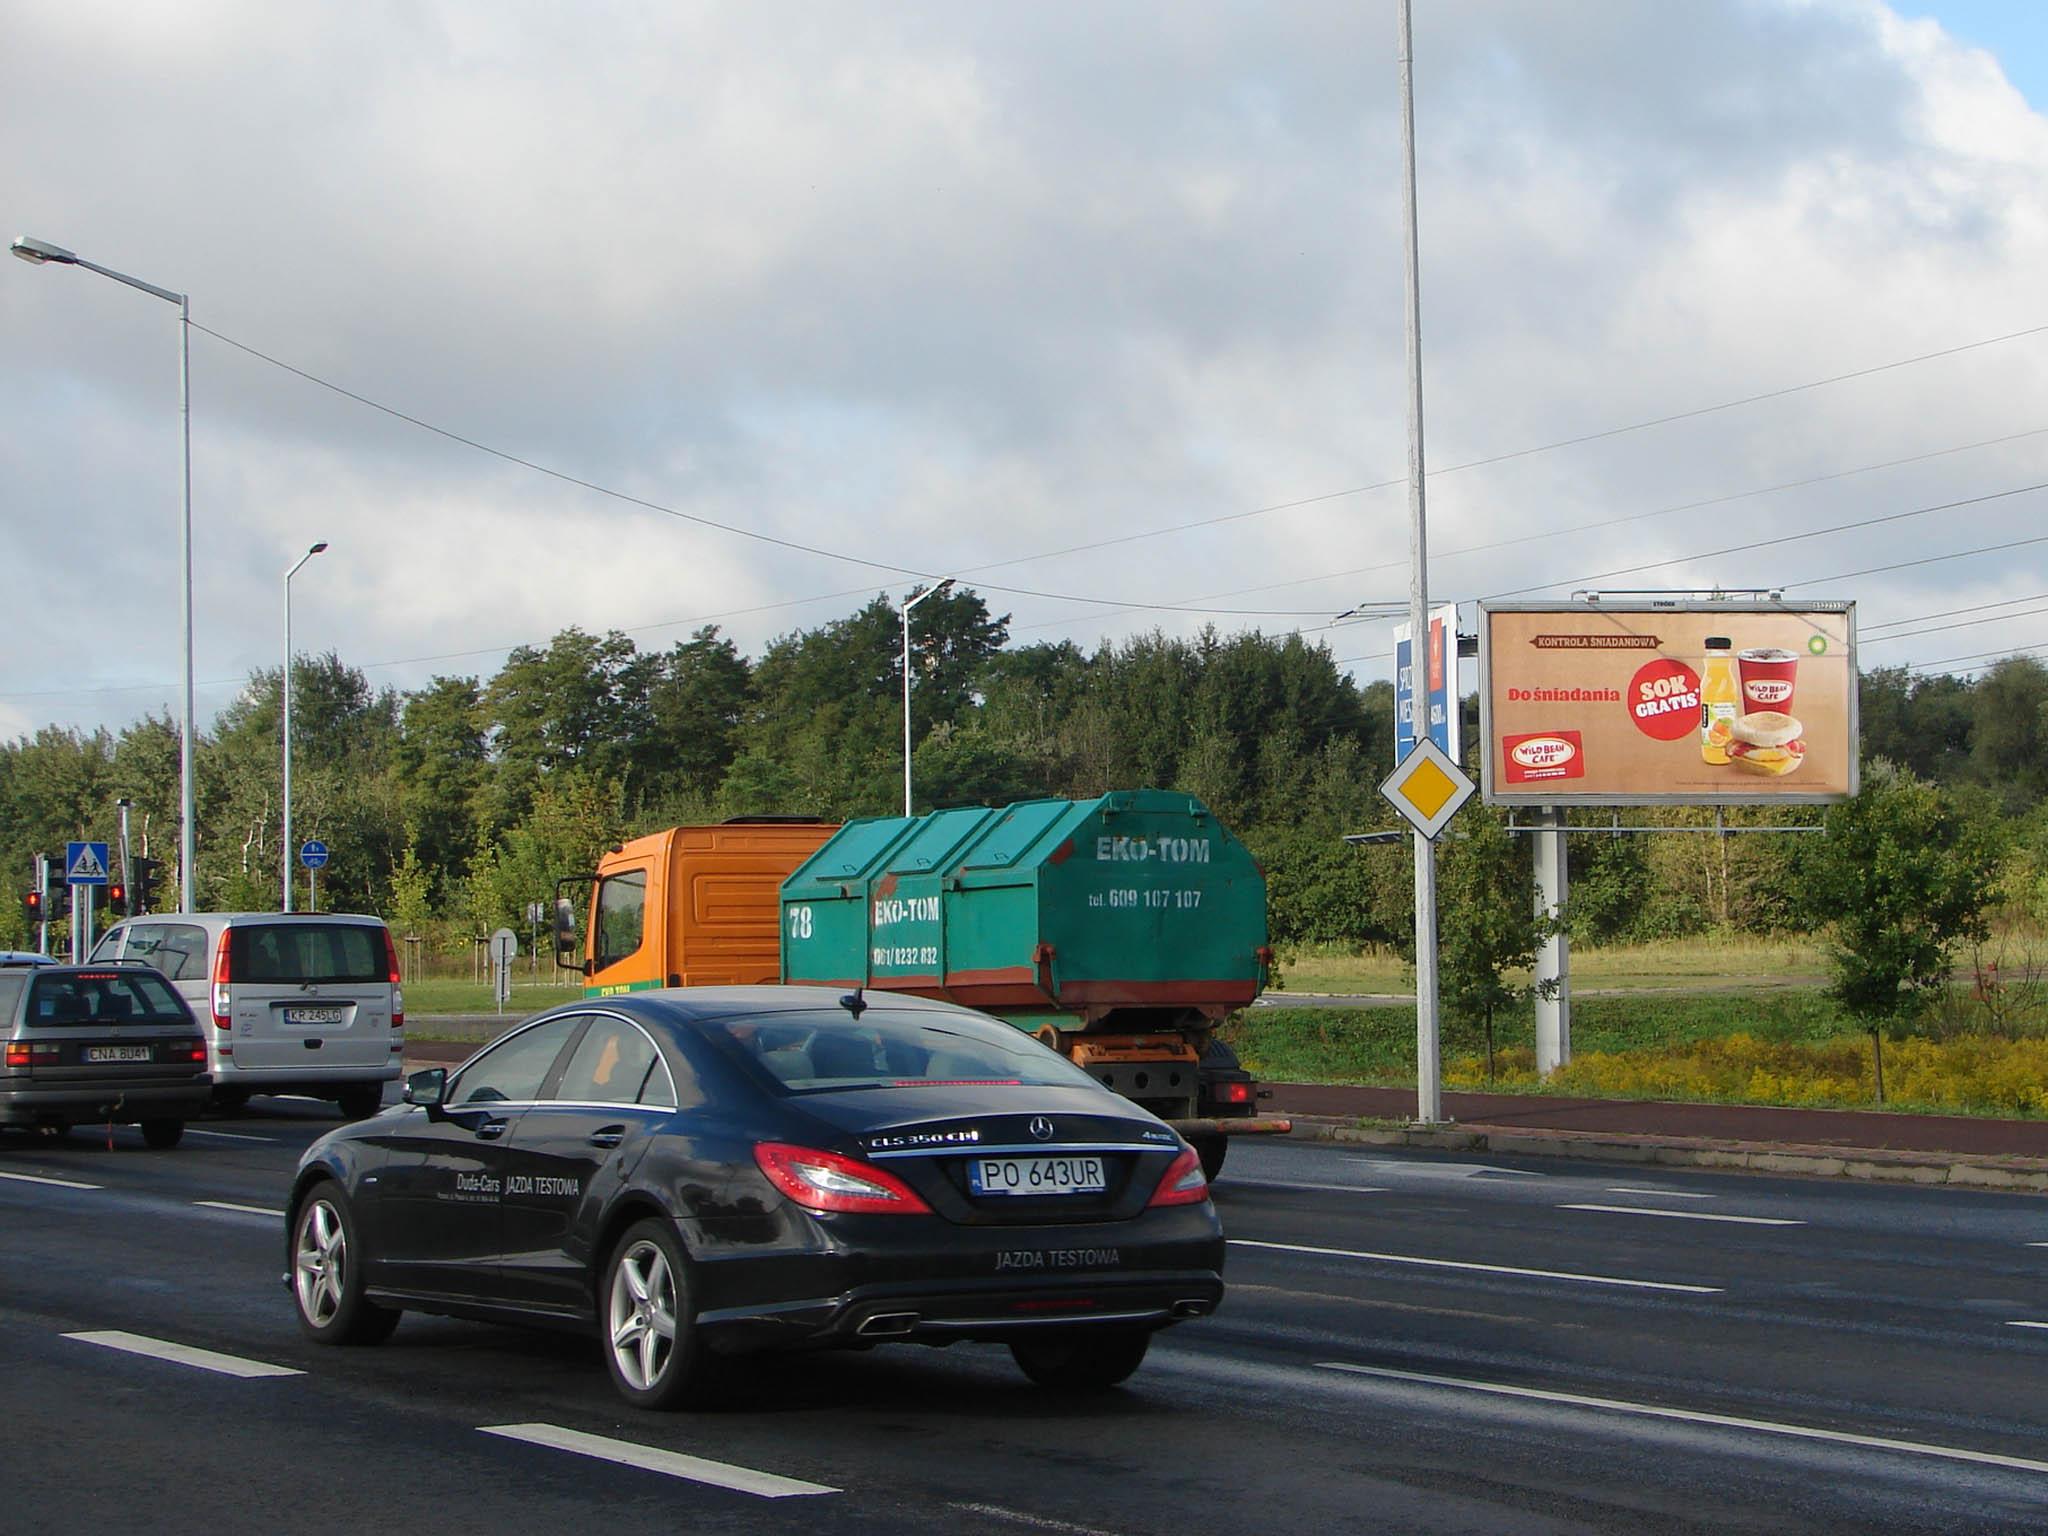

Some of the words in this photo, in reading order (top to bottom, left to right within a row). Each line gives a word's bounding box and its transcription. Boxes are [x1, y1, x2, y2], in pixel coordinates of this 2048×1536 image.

[1538, 637, 1589, 647] KONTROLA
[1590, 636, 1656, 647] ŚNIADANIOWA
[1508, 688, 1531, 701] Do
[1534, 687, 1620, 702] śniadania
[1640, 675, 1688, 701] SOK
[1097, 836, 1210, 863] EKO-TOM
[1089, 892, 1106, 907] tel.
[1109, 889, 1138, 907] 609
[1143, 889, 1170, 908] 107
[1175, 890, 1201, 908] 107
[789, 906, 812, 938] 78
[874, 897, 939, 926] EKO-TOM
[920, 947, 938, 965] 832
[871, 1137, 904, 1147] CLS
[908, 1134, 943, 1145] 350
[457, 1173, 500, 1192] Duda-Cars
[505, 1176, 533, 1195] JAZDA
[535, 1177, 579, 1196] TESTOWA
[984, 1162, 1020, 1188] PO
[1029, 1160, 1101, 1186] 643UR
[995, 1251, 1044, 1270] JAZDA
[1048, 1248, 1120, 1267] TESTOWA
